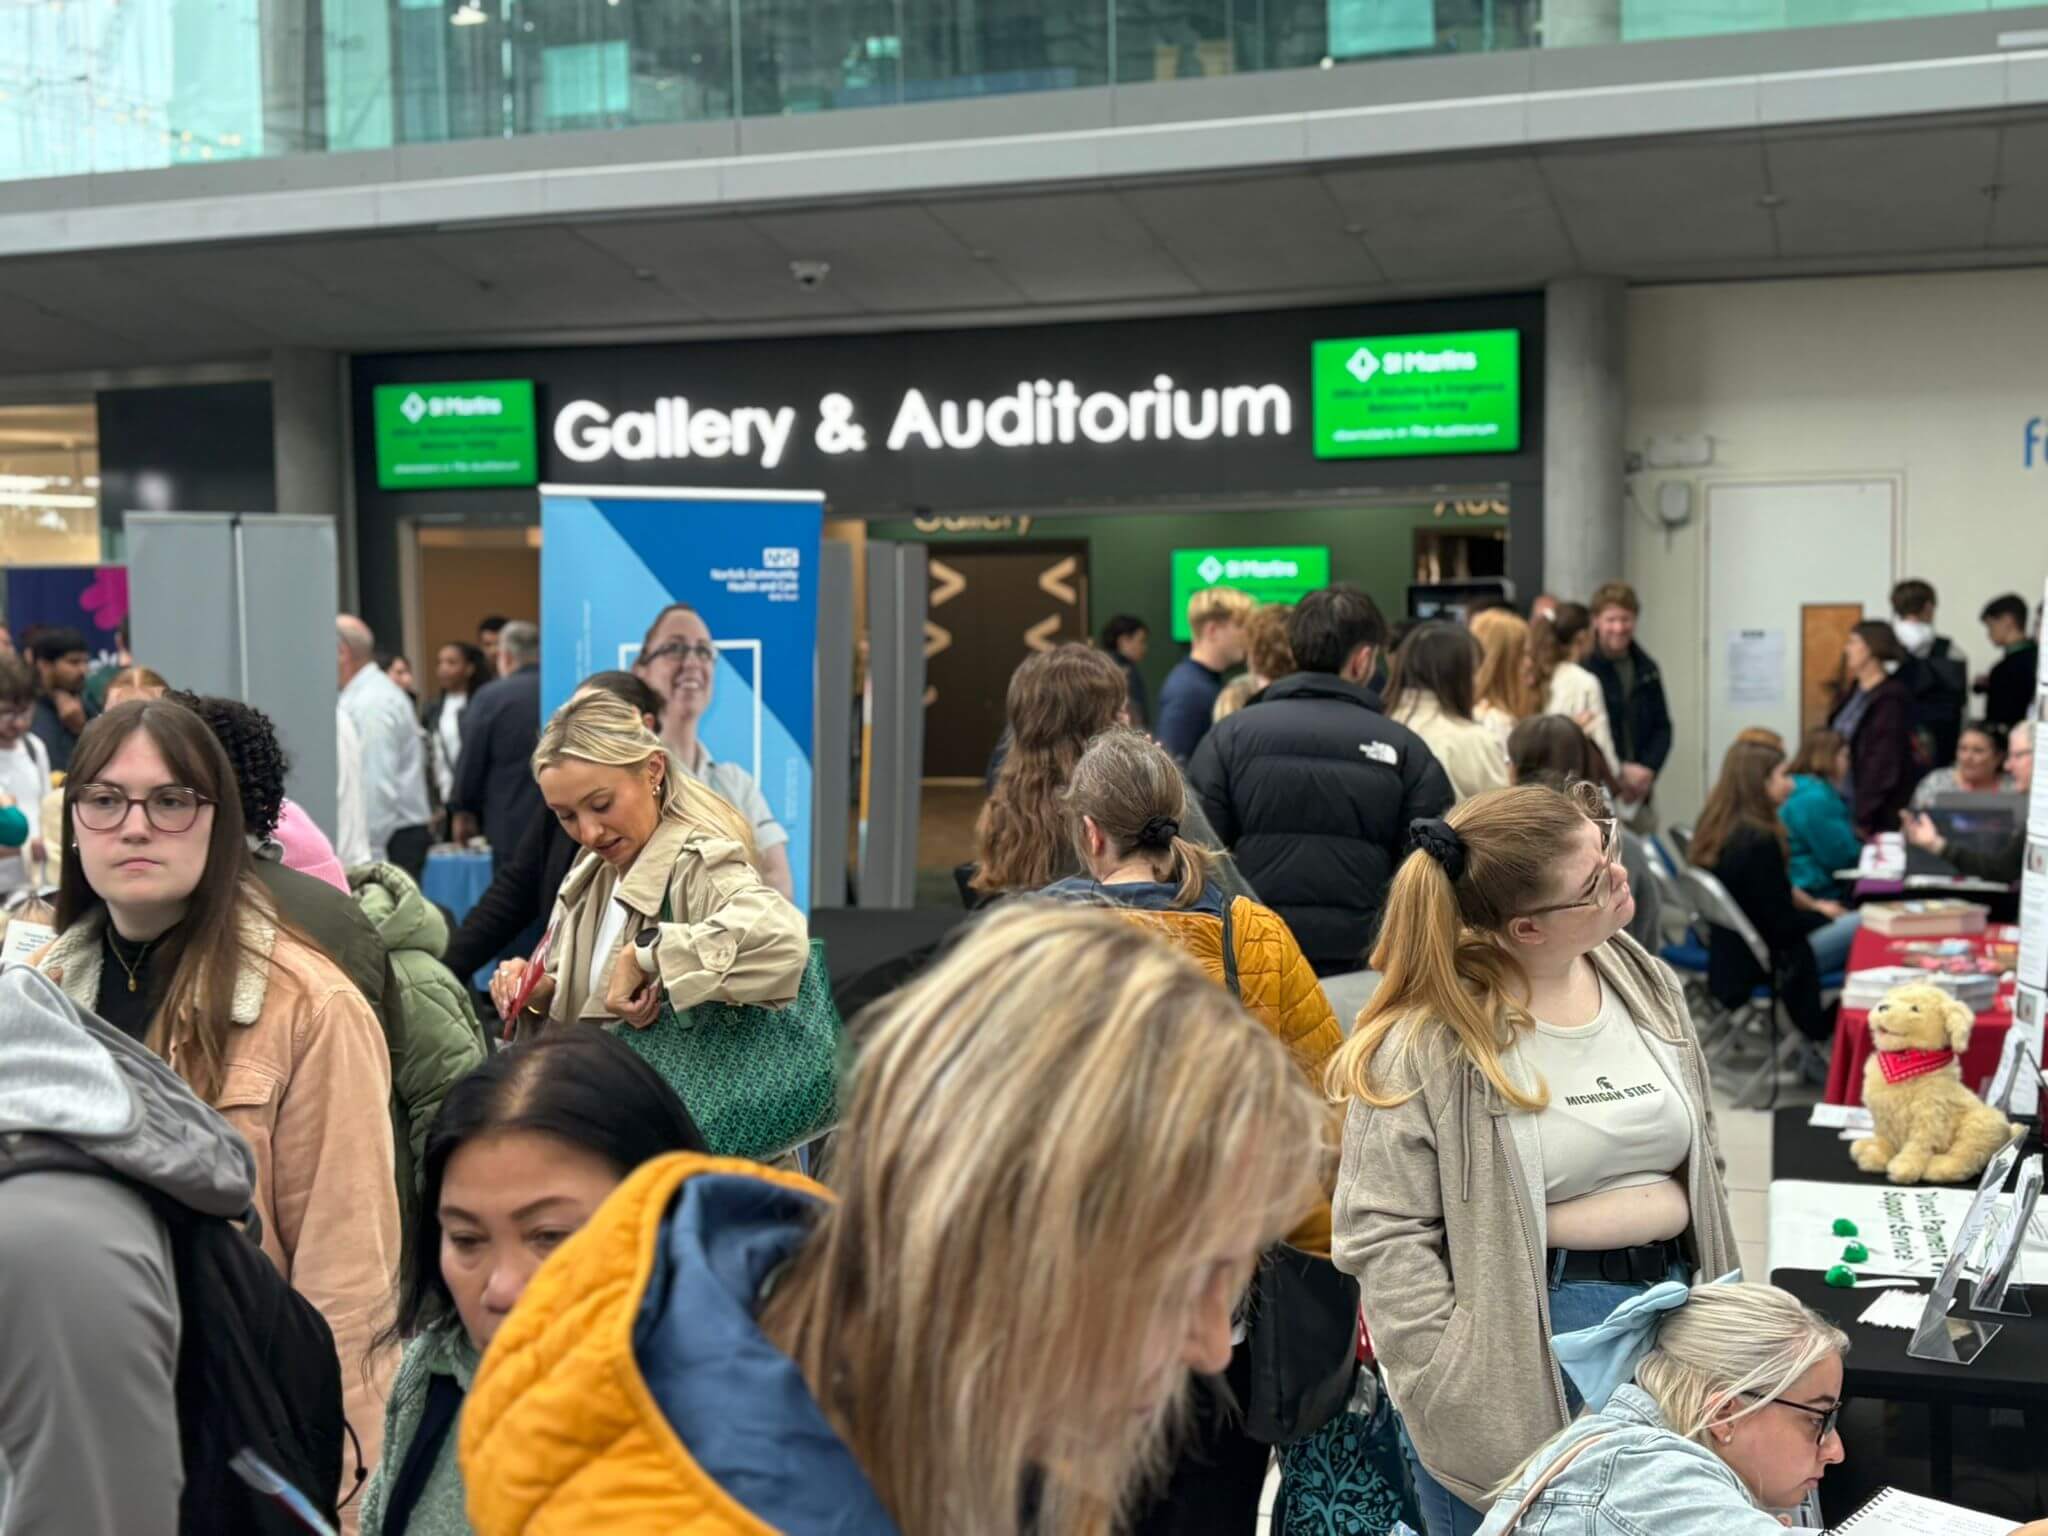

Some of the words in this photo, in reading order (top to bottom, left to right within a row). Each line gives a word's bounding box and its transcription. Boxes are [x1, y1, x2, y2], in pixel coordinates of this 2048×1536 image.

[553, 396, 796, 468] Gallery
[815, 393, 867, 453] &
[887, 374, 1291, 450] Auditorium
[1565, 1090, 1625, 1106] MICHIGAN
[1623, 1083, 1660, 1098] STATE
[1878, 1192, 1908, 1224] Support
[1888, 1223, 1914, 1261] Service
[1918, 1219, 1948, 1259] Payment
